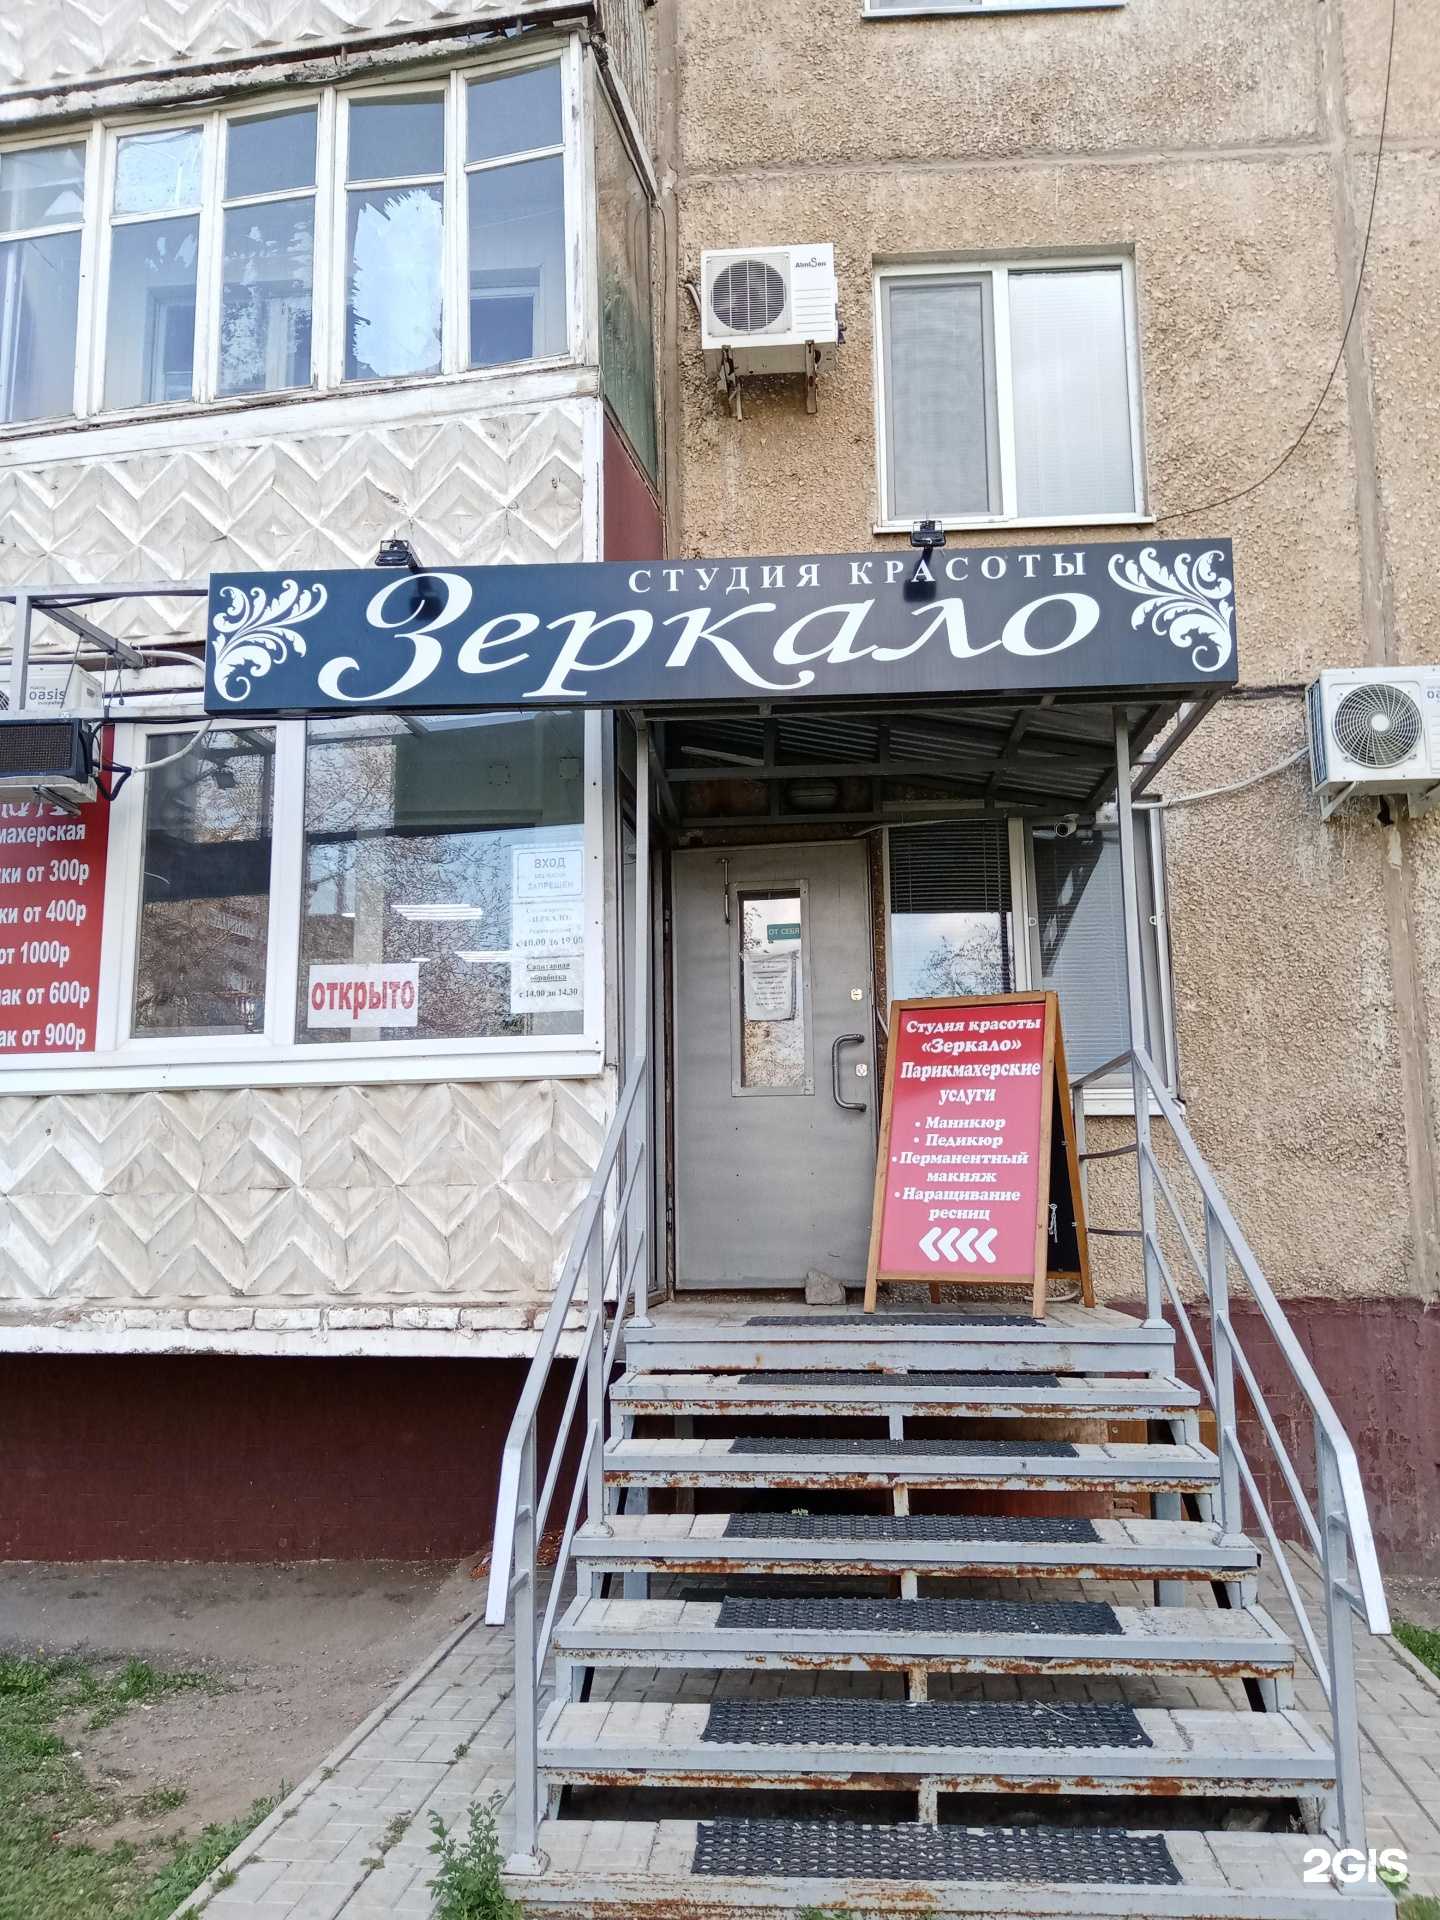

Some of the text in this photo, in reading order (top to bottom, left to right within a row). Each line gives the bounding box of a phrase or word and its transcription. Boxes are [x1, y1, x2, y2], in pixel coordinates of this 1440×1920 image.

[628, 551, 1087, 597] СТУДИЯ КРАСОТЫ
[317, 572, 1101, 701] Зеркало
[534, 857, 567, 869] ВХОД
[26, 866, 45, 882] от
[49, 858, 90, 886] 300р
[23, 906, 42, 923] от
[45, 899, 87, 927] 400р
[20, 940, 70, 968] 1000р
[26, 987, 45, 1005] от
[49, 980, 90, 1009] 600р
[906, 1018, 1041, 1034] Студия красоты
[21, 1029, 40, 1047] от
[45, 1022, 86, 1050] 900р
[921, 1038, 1022, 1056] «Зеркало»
[900, 1061, 1041, 1081] Парикмахерские
[938, 1088, 997, 1105] услуги
[925, 1116, 1006, 1131] Маникюр
[925, 1133, 1004, 1148] Педикюр
[899, 1151, 1030, 1166] Перманентный
[926, 1171, 998, 1182] макияж
[902, 1186, 1021, 1202] Наращивание
[928, 1207, 991, 1221] ресниц
